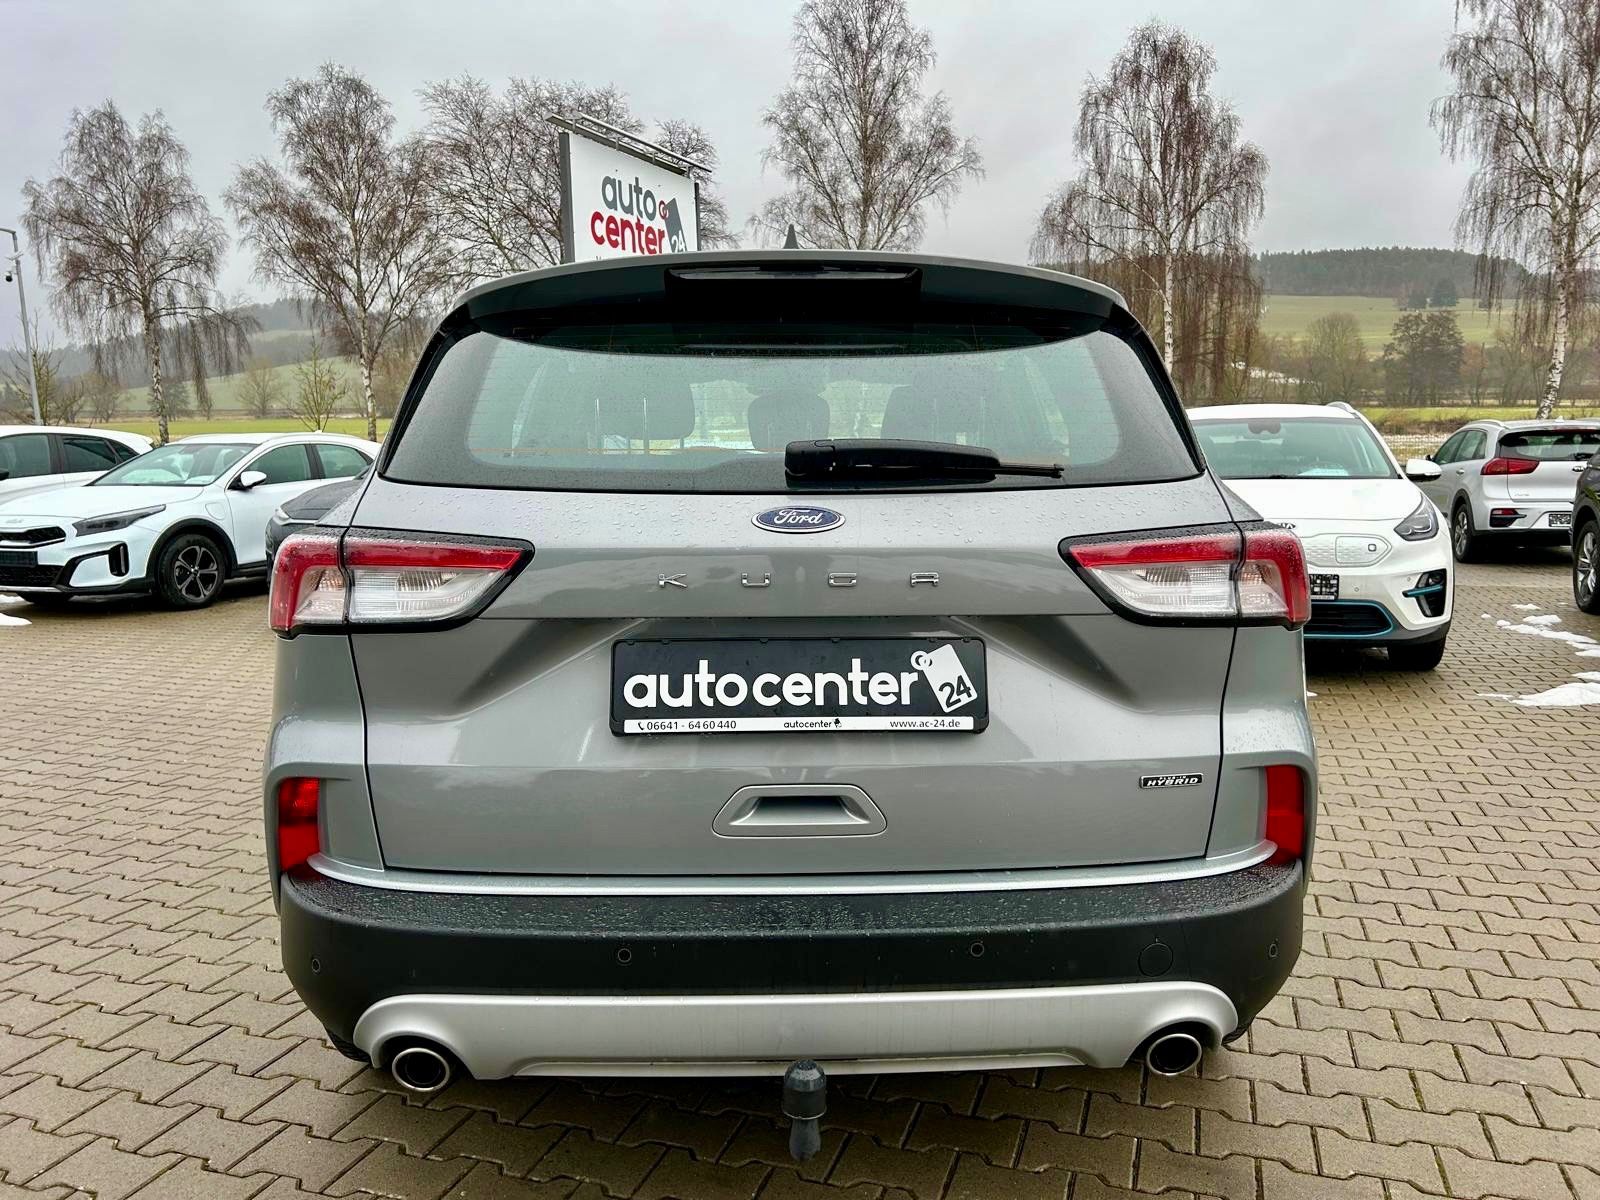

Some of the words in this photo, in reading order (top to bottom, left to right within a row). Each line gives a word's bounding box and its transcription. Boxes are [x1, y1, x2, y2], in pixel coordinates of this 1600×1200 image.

[601, 175, 656, 221] auto
[591, 211, 665, 255] center
[671, 230, 686, 253] 24
[774, 508, 824, 526] Ford
[658, 571, 940, 588] KUGA
[623, 658, 919, 708] autocenter
[938, 674, 973, 709] 24
[646, 721, 678, 730] 06641
[783, 719, 832, 729] autocenter
[889, 718, 961, 729] www.ac-24.de
[1147, 777, 1198, 786] HYBRID
